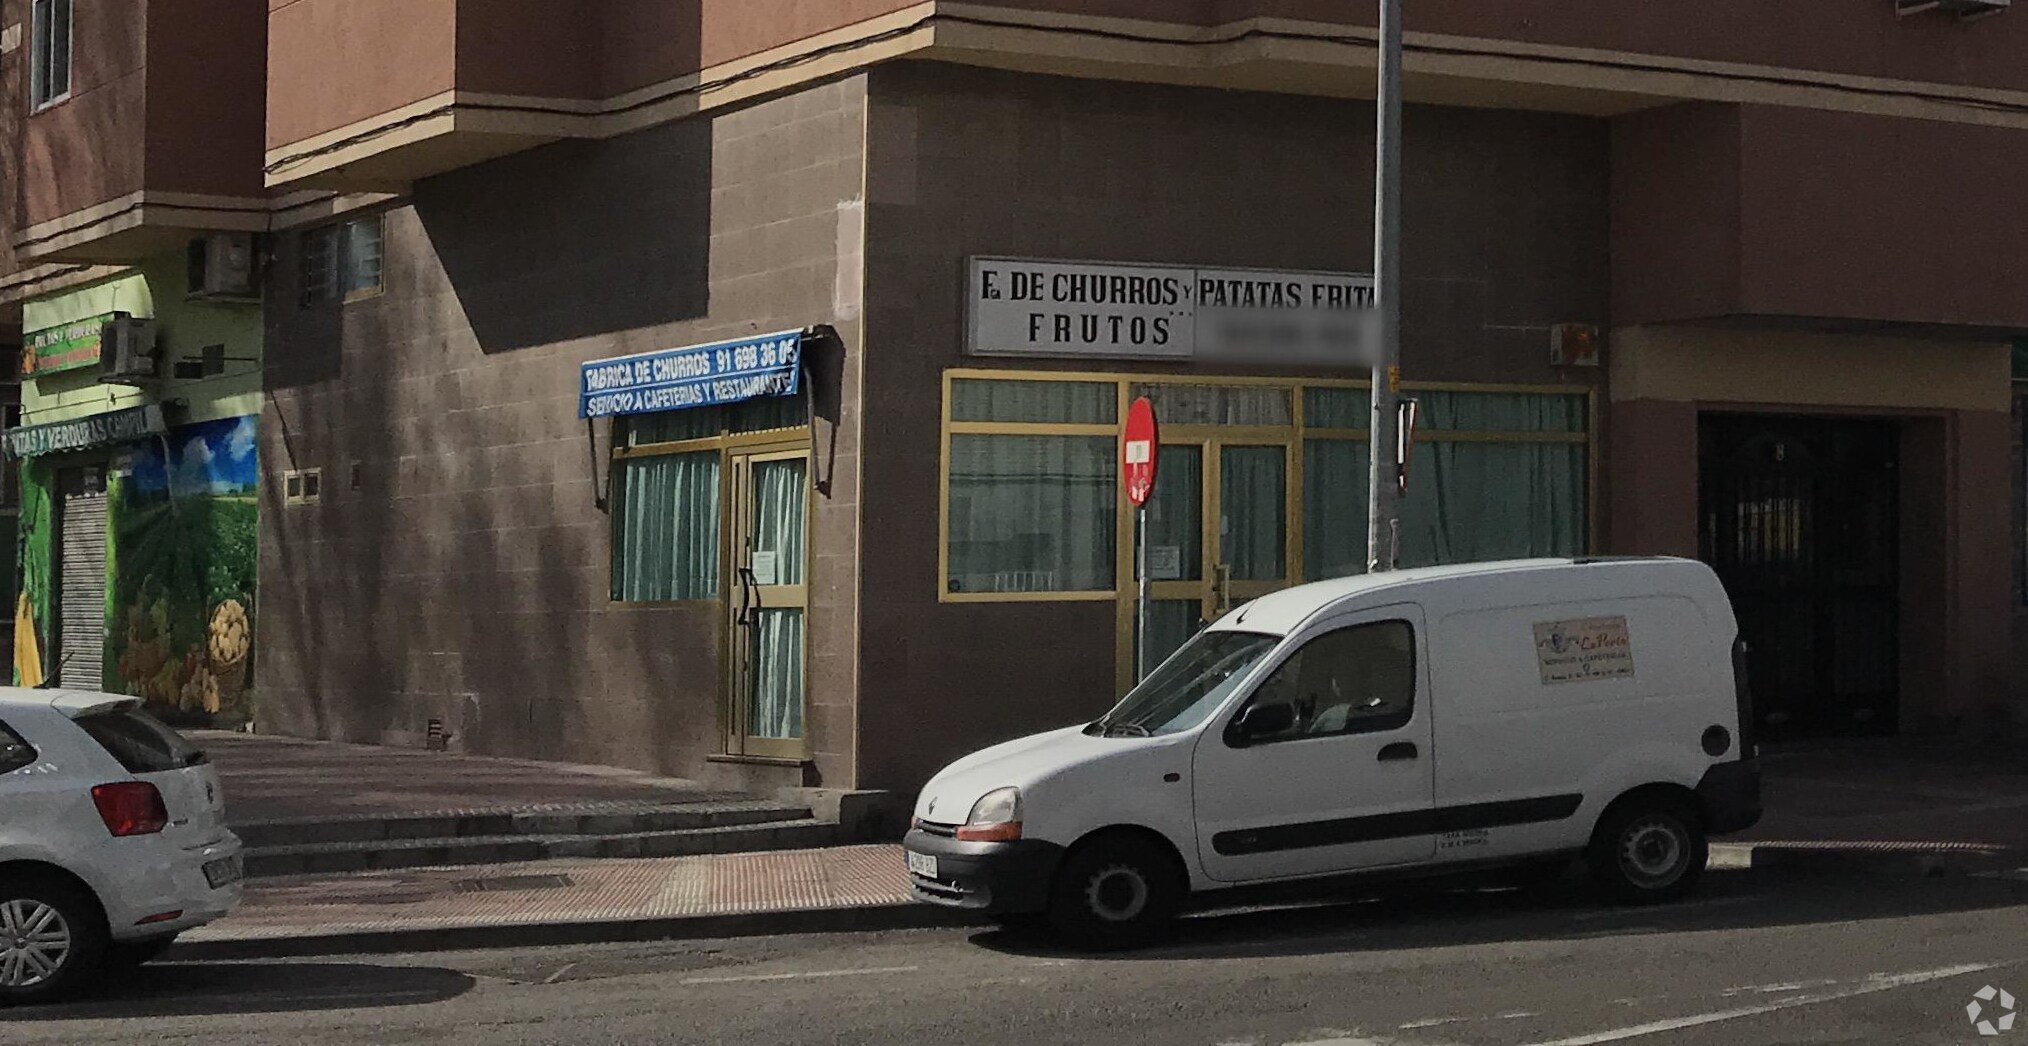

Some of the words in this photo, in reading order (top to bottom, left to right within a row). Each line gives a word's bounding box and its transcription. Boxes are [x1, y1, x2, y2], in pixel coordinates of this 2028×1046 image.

[1010, 271, 1044, 301] DE
[1052, 273, 1179, 305] CHURROS
[1183, 285, 1193, 299] Y
[1199, 278, 1302, 309] PATATAS
[1312, 284, 1375, 309] FRITA
[1029, 313, 1170, 345] FRUTOS
[586, 363, 633, 391] FABRICA
[635, 360, 652, 384] DE
[653, 351, 710, 382] CHURROS
[716, 348, 731, 373] 91
[734, 344, 758, 370] 698
[760, 341, 776, 367] 36
[632, 390, 643, 411] A
[644, 383, 703, 409] CAFETERIAS
[702, 382, 711, 402] Y
